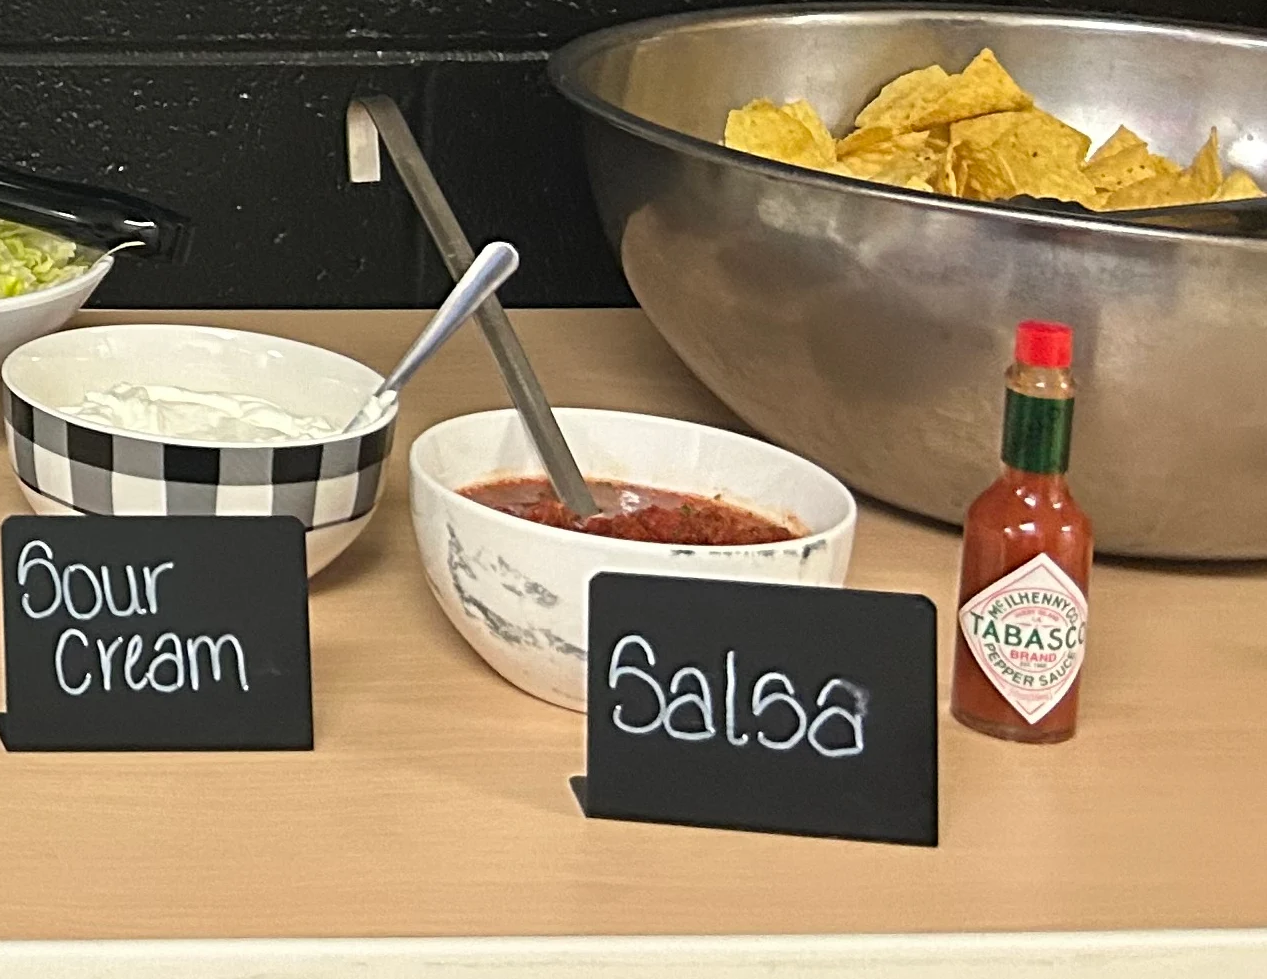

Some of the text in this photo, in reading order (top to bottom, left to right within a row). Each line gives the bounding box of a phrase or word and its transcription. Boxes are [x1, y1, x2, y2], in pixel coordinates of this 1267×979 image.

[17, 540, 174, 619] Sour
[55, 628, 250, 695] Cream
[984, 643, 1035, 687] PEPPER
[1009, 648, 1057, 663] BRAND
[609, 635, 868, 757] Salsa
